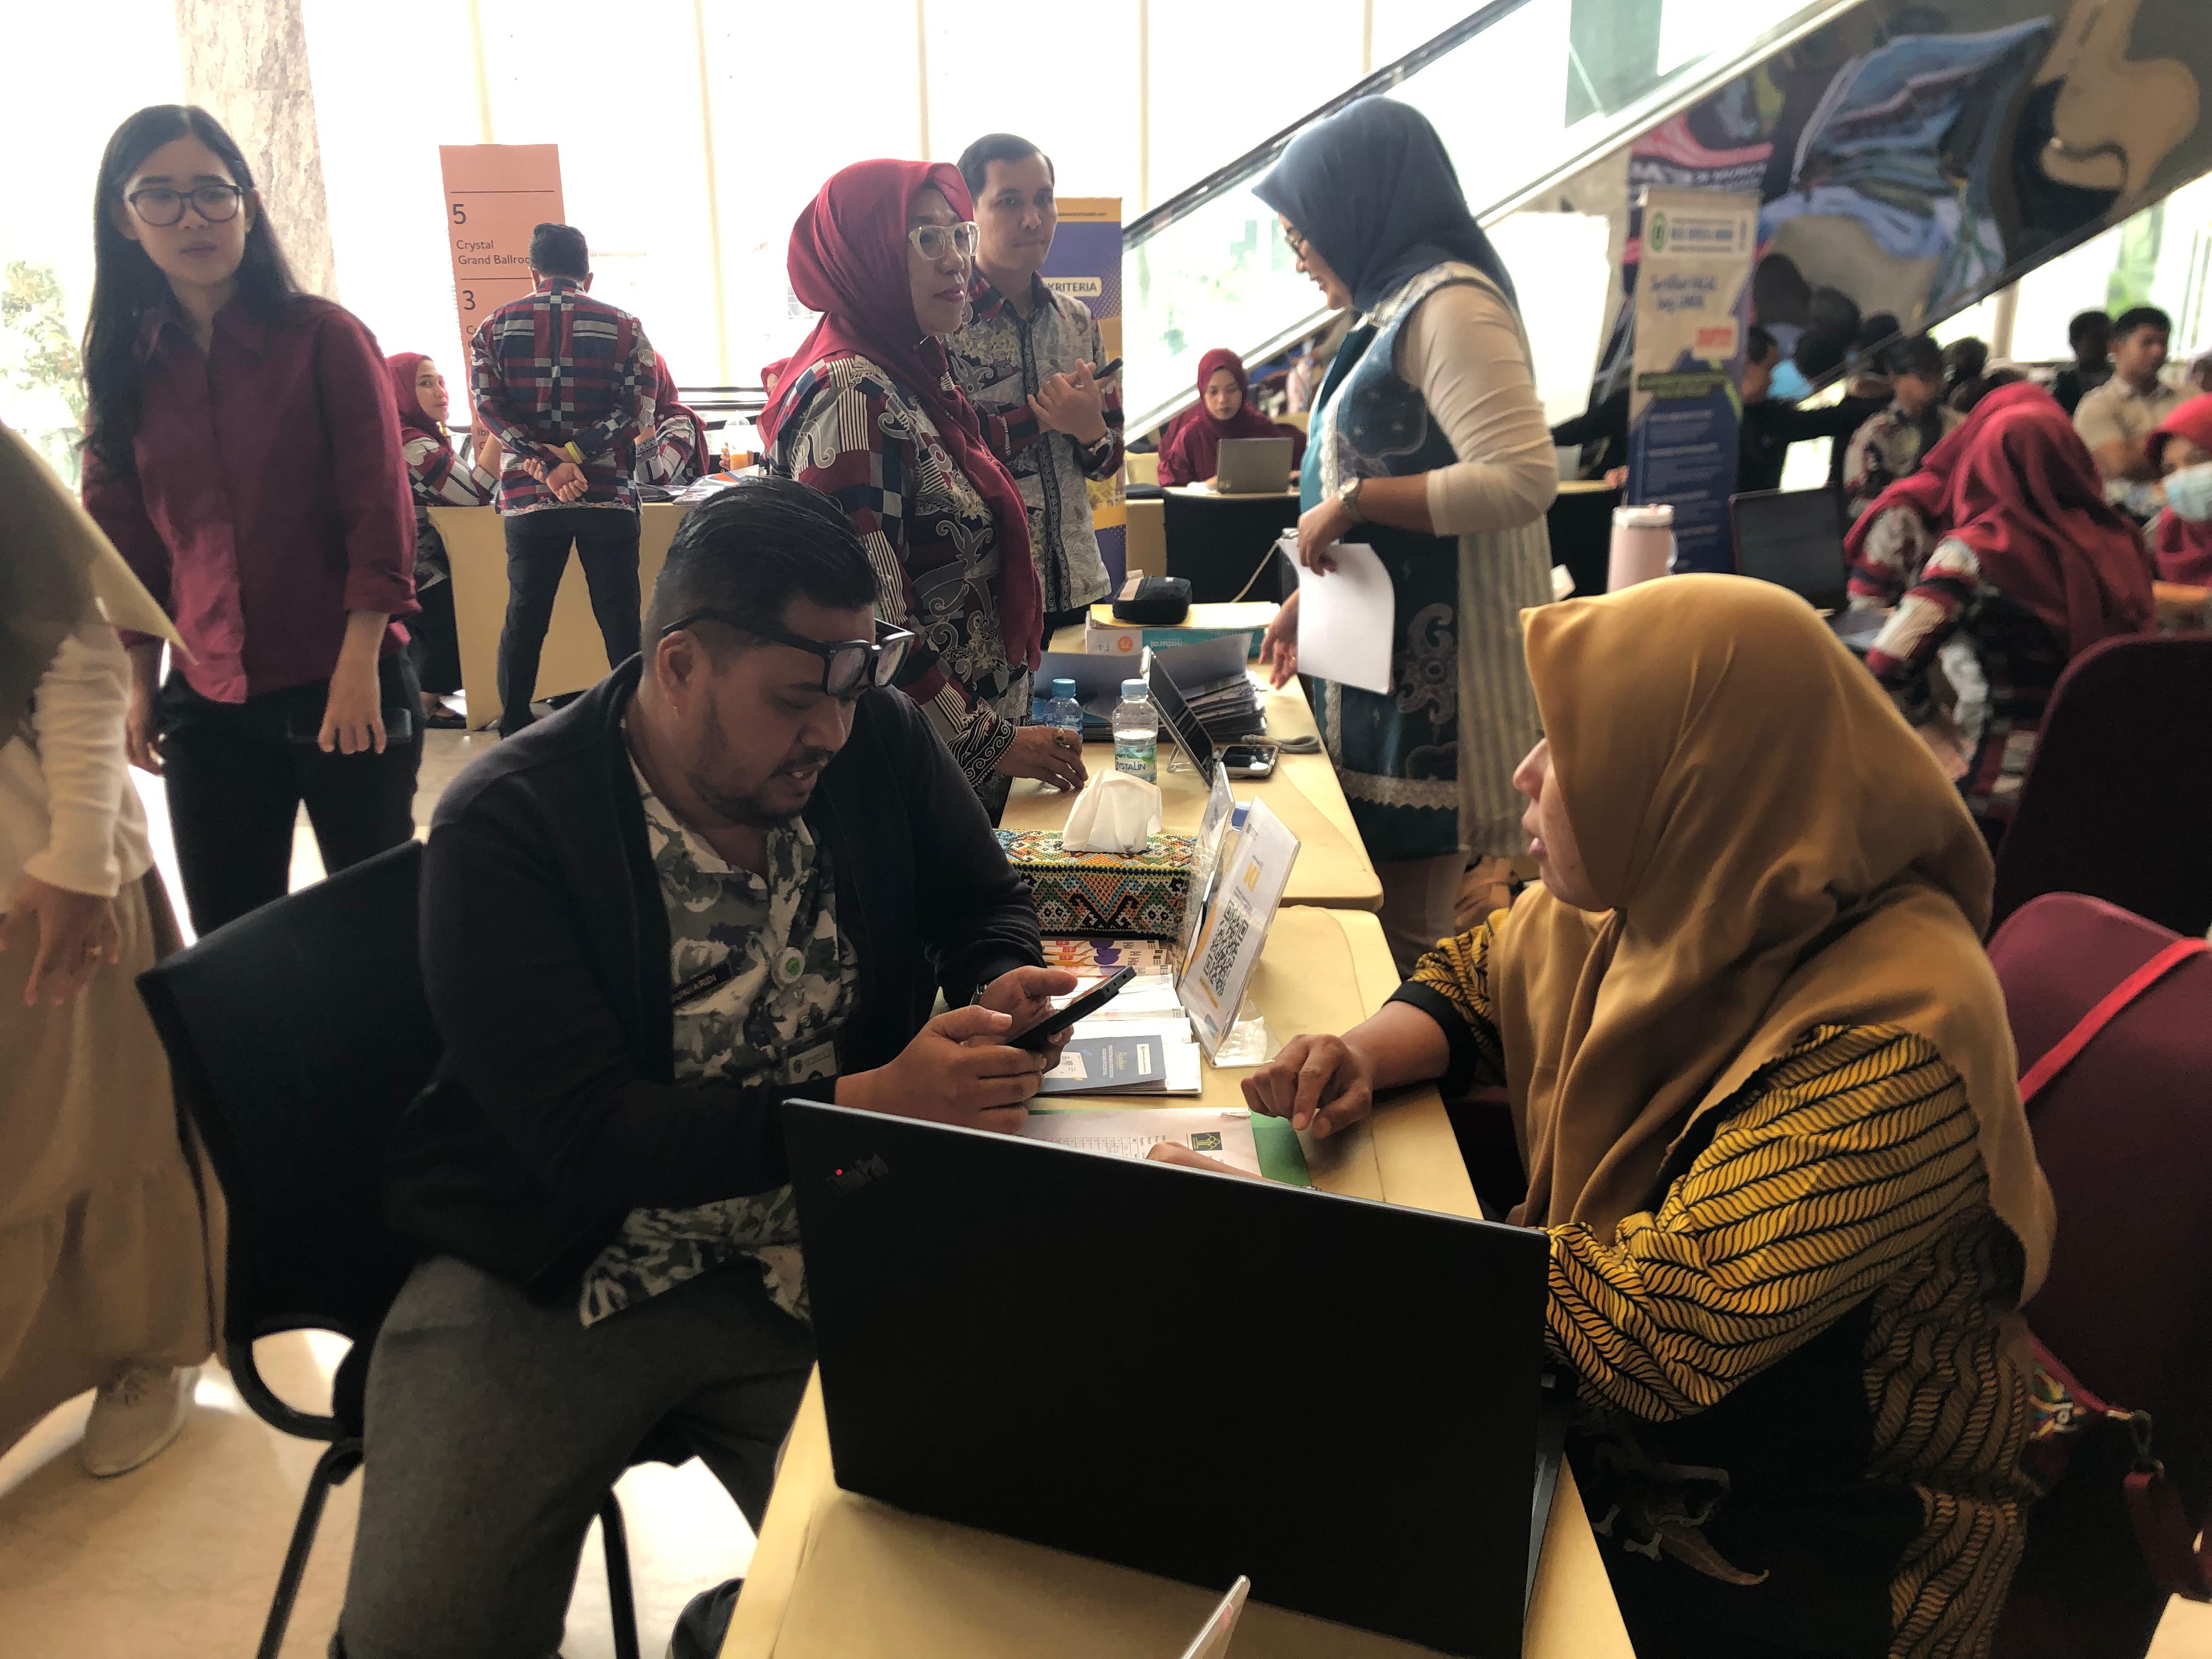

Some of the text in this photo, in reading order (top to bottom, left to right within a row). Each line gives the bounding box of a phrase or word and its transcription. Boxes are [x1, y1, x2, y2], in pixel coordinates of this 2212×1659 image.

[453, 204, 466, 224] 5
[456, 240, 494, 252] Crystal
[458, 255, 531, 264] Grand Ballroo
[462, 290, 476, 310] 3
